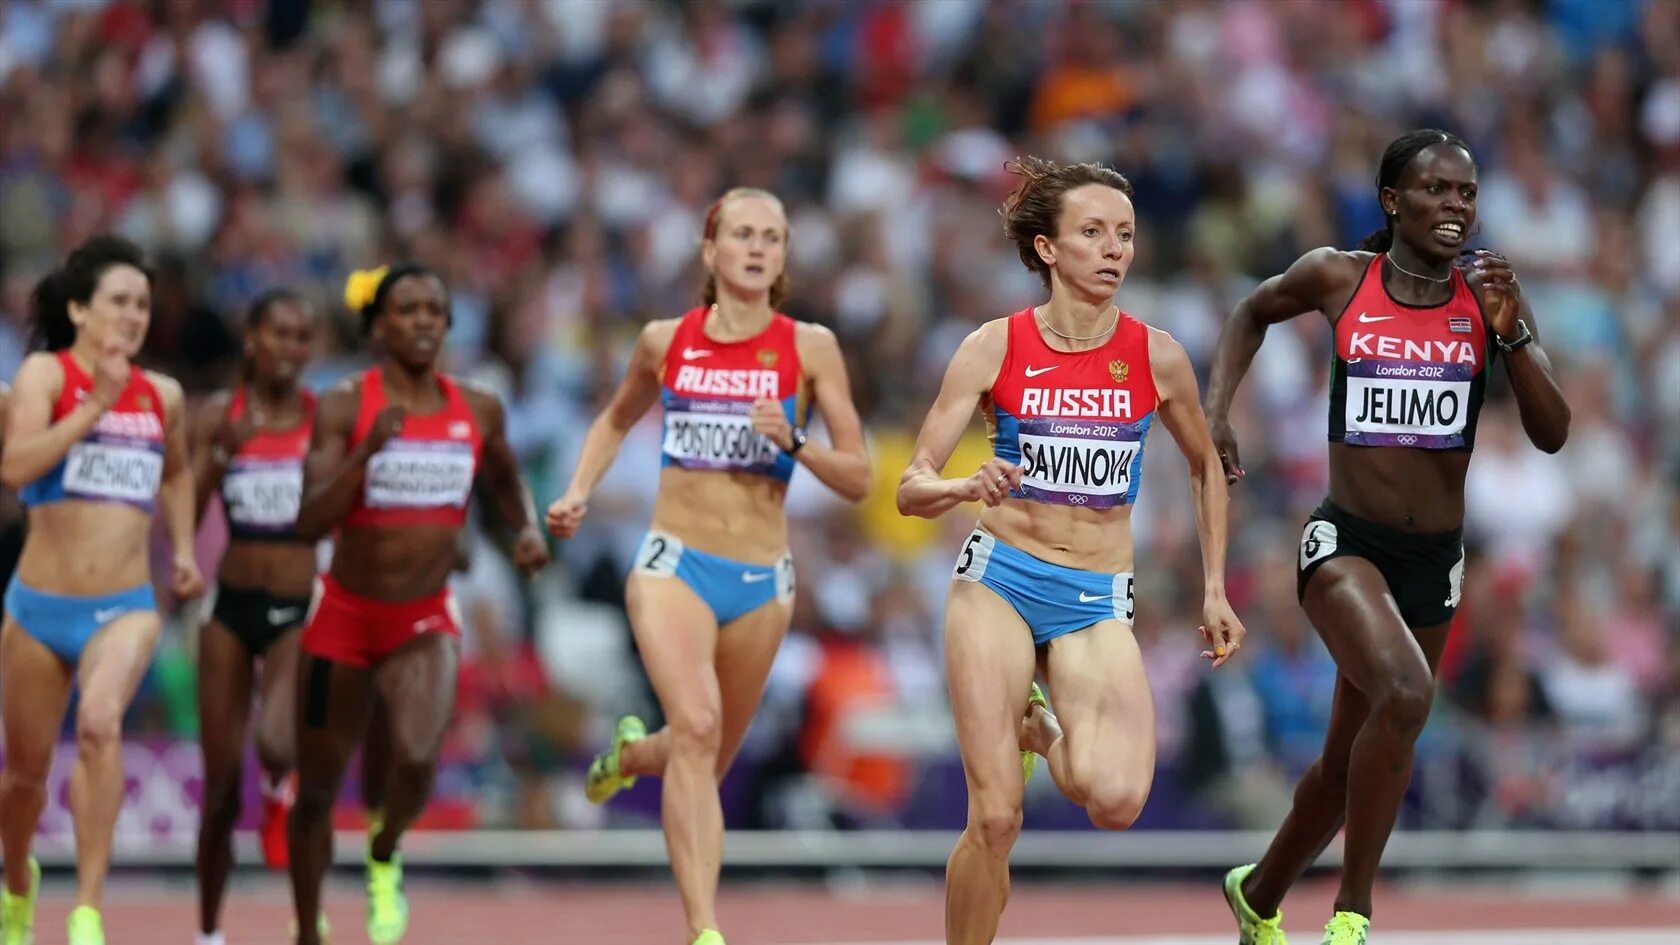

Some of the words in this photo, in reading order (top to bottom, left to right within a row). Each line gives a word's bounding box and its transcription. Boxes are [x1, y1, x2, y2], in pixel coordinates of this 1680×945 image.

[1349, 332, 1476, 365] KENYA
[676, 365, 779, 398] RUSSIA
[1376, 364, 1416, 377] London
[1418, 366, 1445, 378] 2012
[1020, 388, 1132, 418] RUSSIA
[1356, 387, 1458, 426] JELIMO
[1050, 422, 1091, 435] London
[1092, 425, 1119, 437] 2012
[1022, 442, 1133, 486] SAVINOVA
[645, 536, 667, 570] 2
[957, 534, 982, 574] 5
[1305, 525, 1321, 559] 6
[1126, 578, 1135, 619] 5
